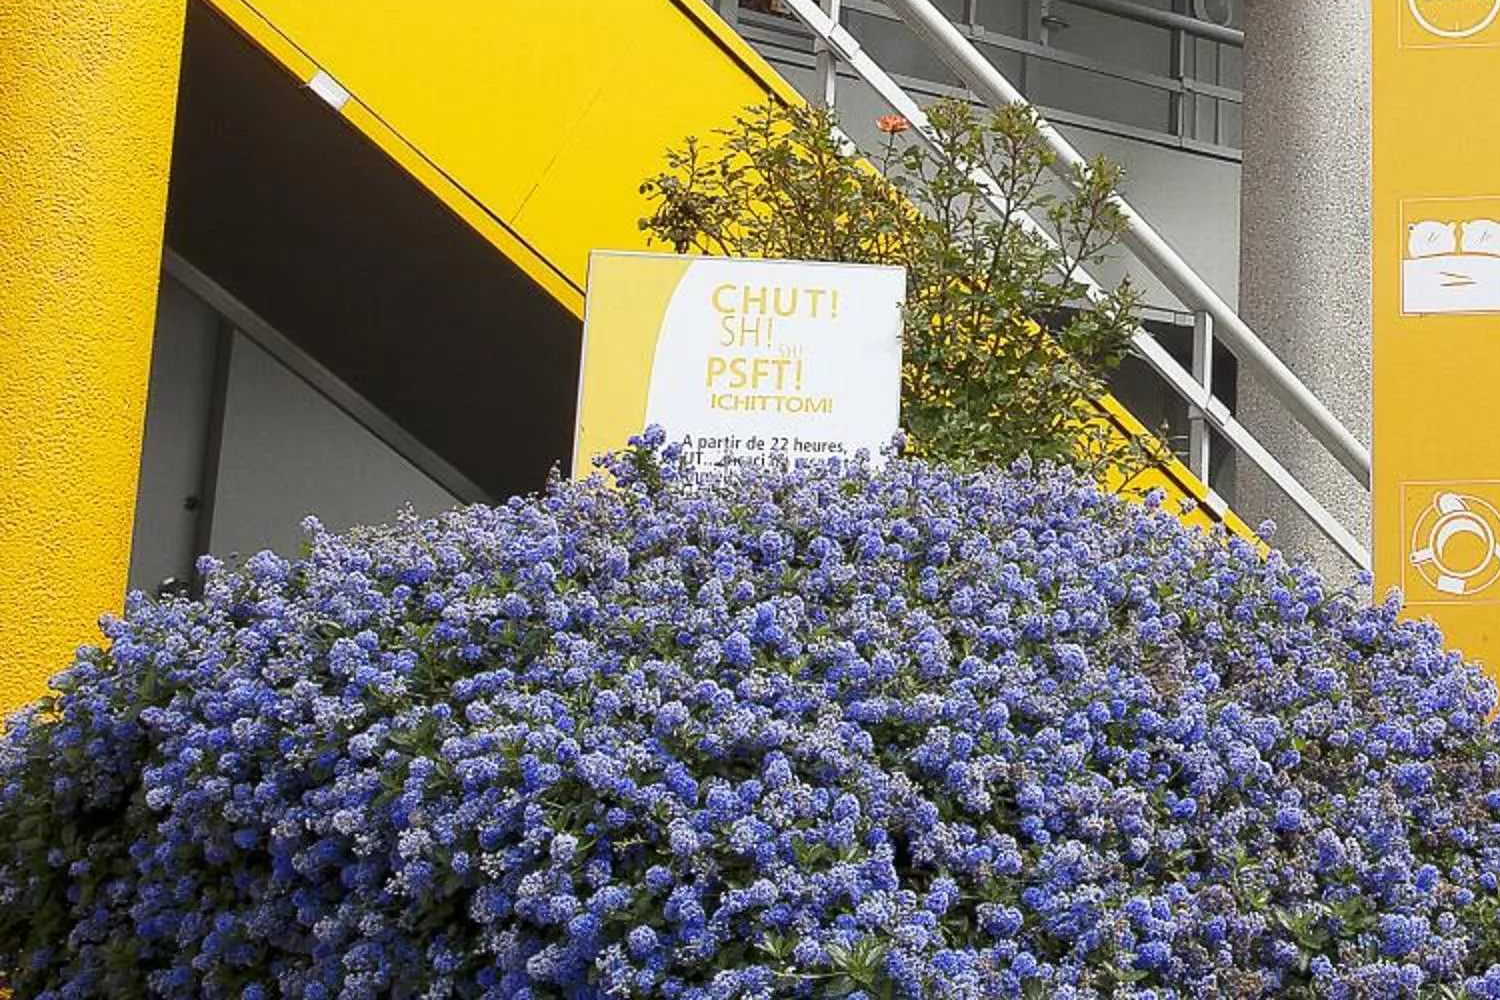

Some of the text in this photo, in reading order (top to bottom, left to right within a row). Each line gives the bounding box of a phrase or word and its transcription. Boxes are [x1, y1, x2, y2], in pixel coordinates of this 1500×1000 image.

[711, 283, 838, 319] CHUT!
[720, 315, 773, 348] SH!
[705, 357, 803, 391] PSFT!
[682, 433, 847, 455] A partir de 22 heures,
